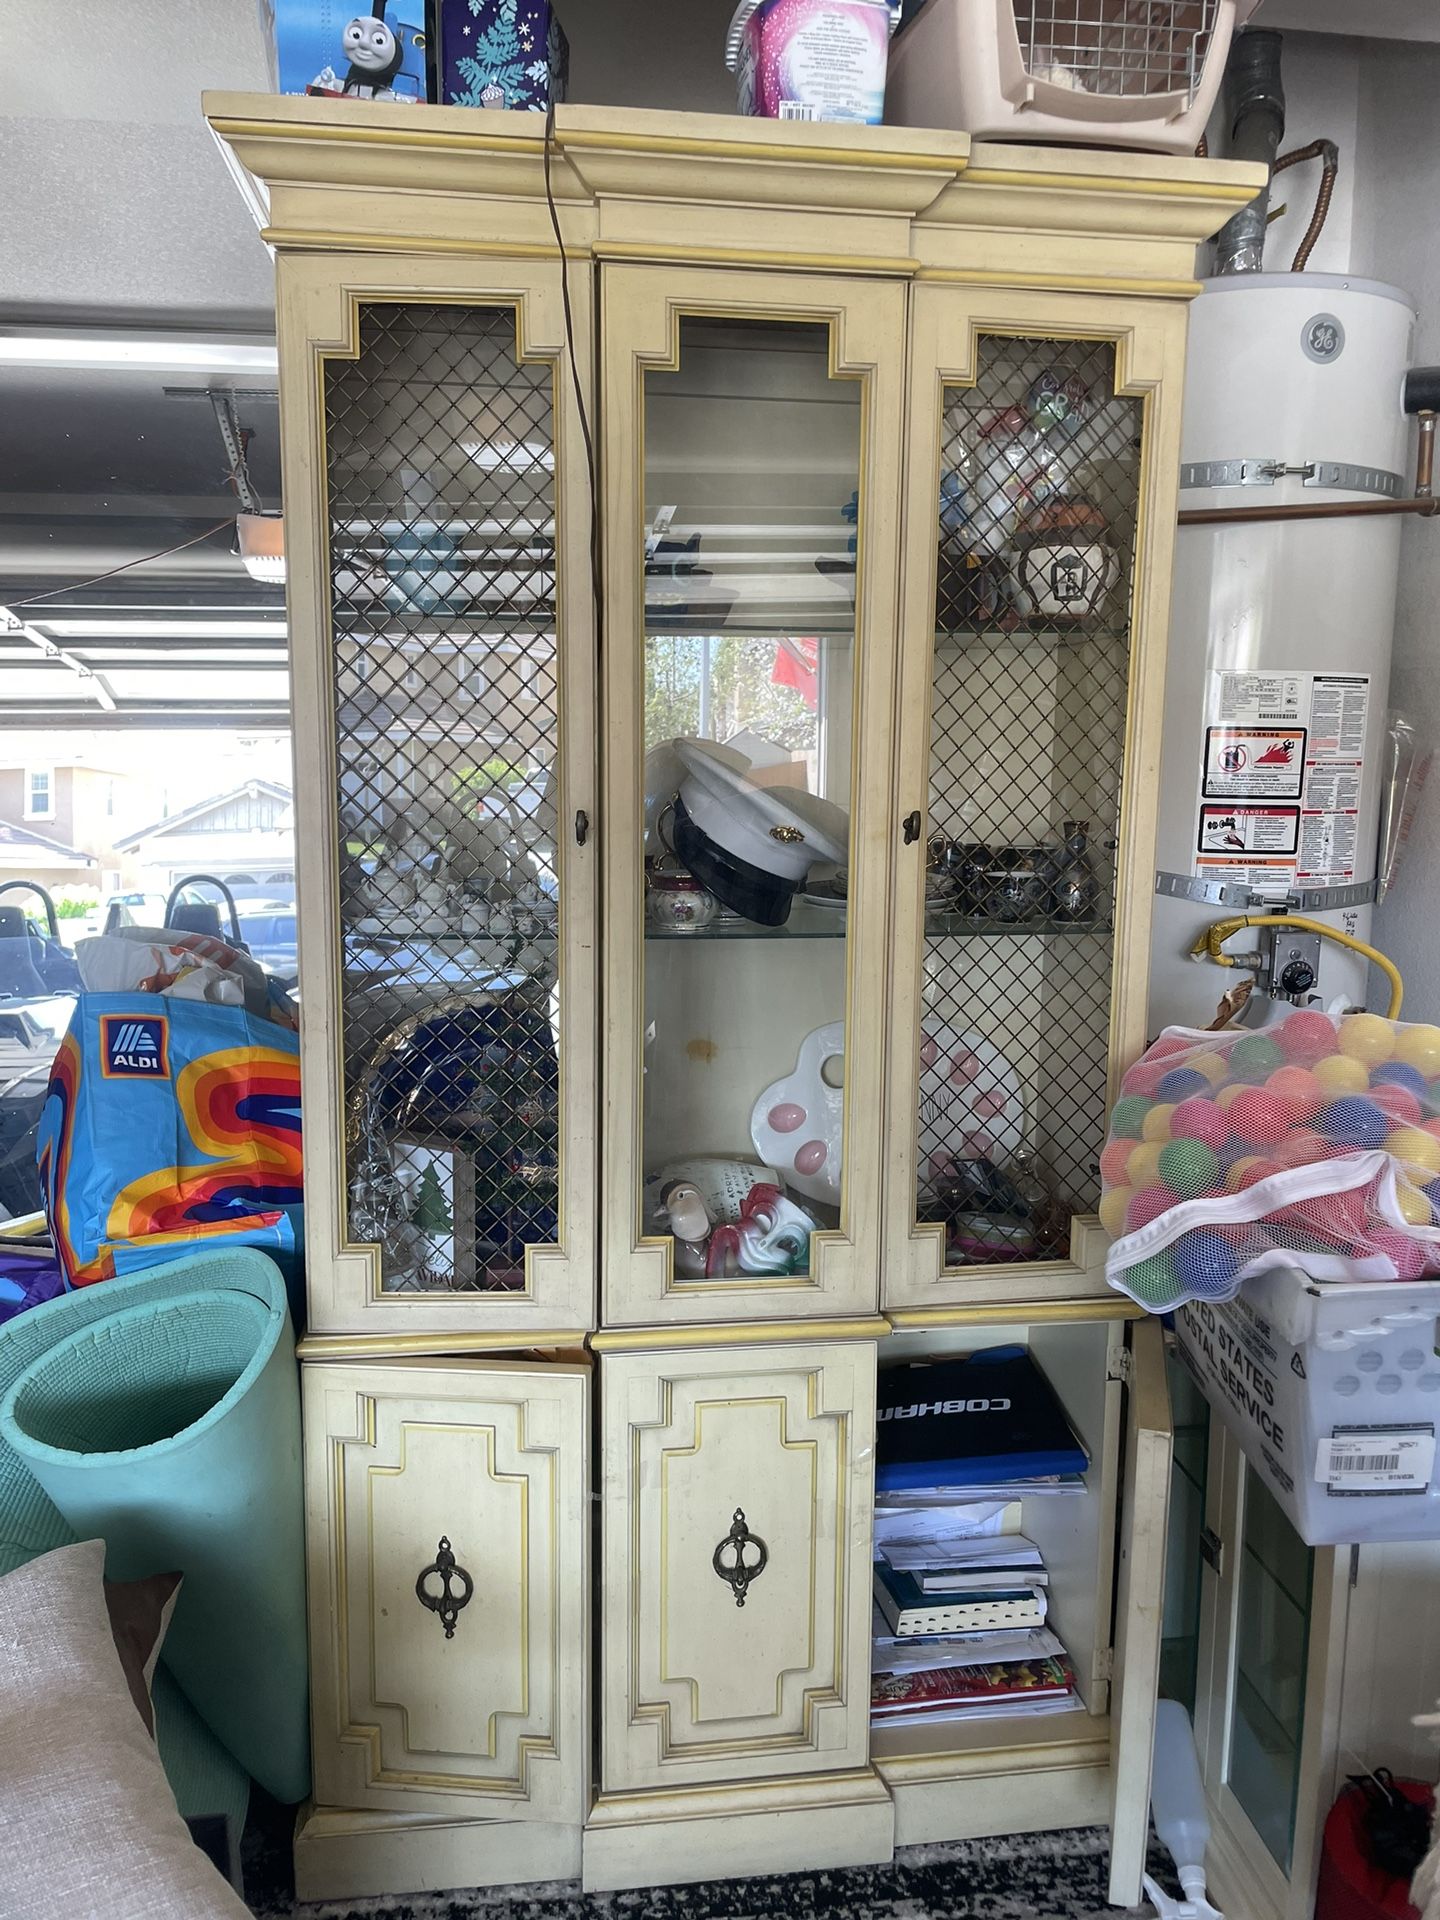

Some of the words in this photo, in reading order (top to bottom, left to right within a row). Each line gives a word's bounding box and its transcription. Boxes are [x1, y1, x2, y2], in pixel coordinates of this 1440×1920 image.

[113, 1054, 158, 1069] ALDI
[1180, 1304, 1218, 1370] OSTAL
[1220, 1358, 1284, 1453] SERVICE
[1218, 1325, 1274, 1407] STATES
